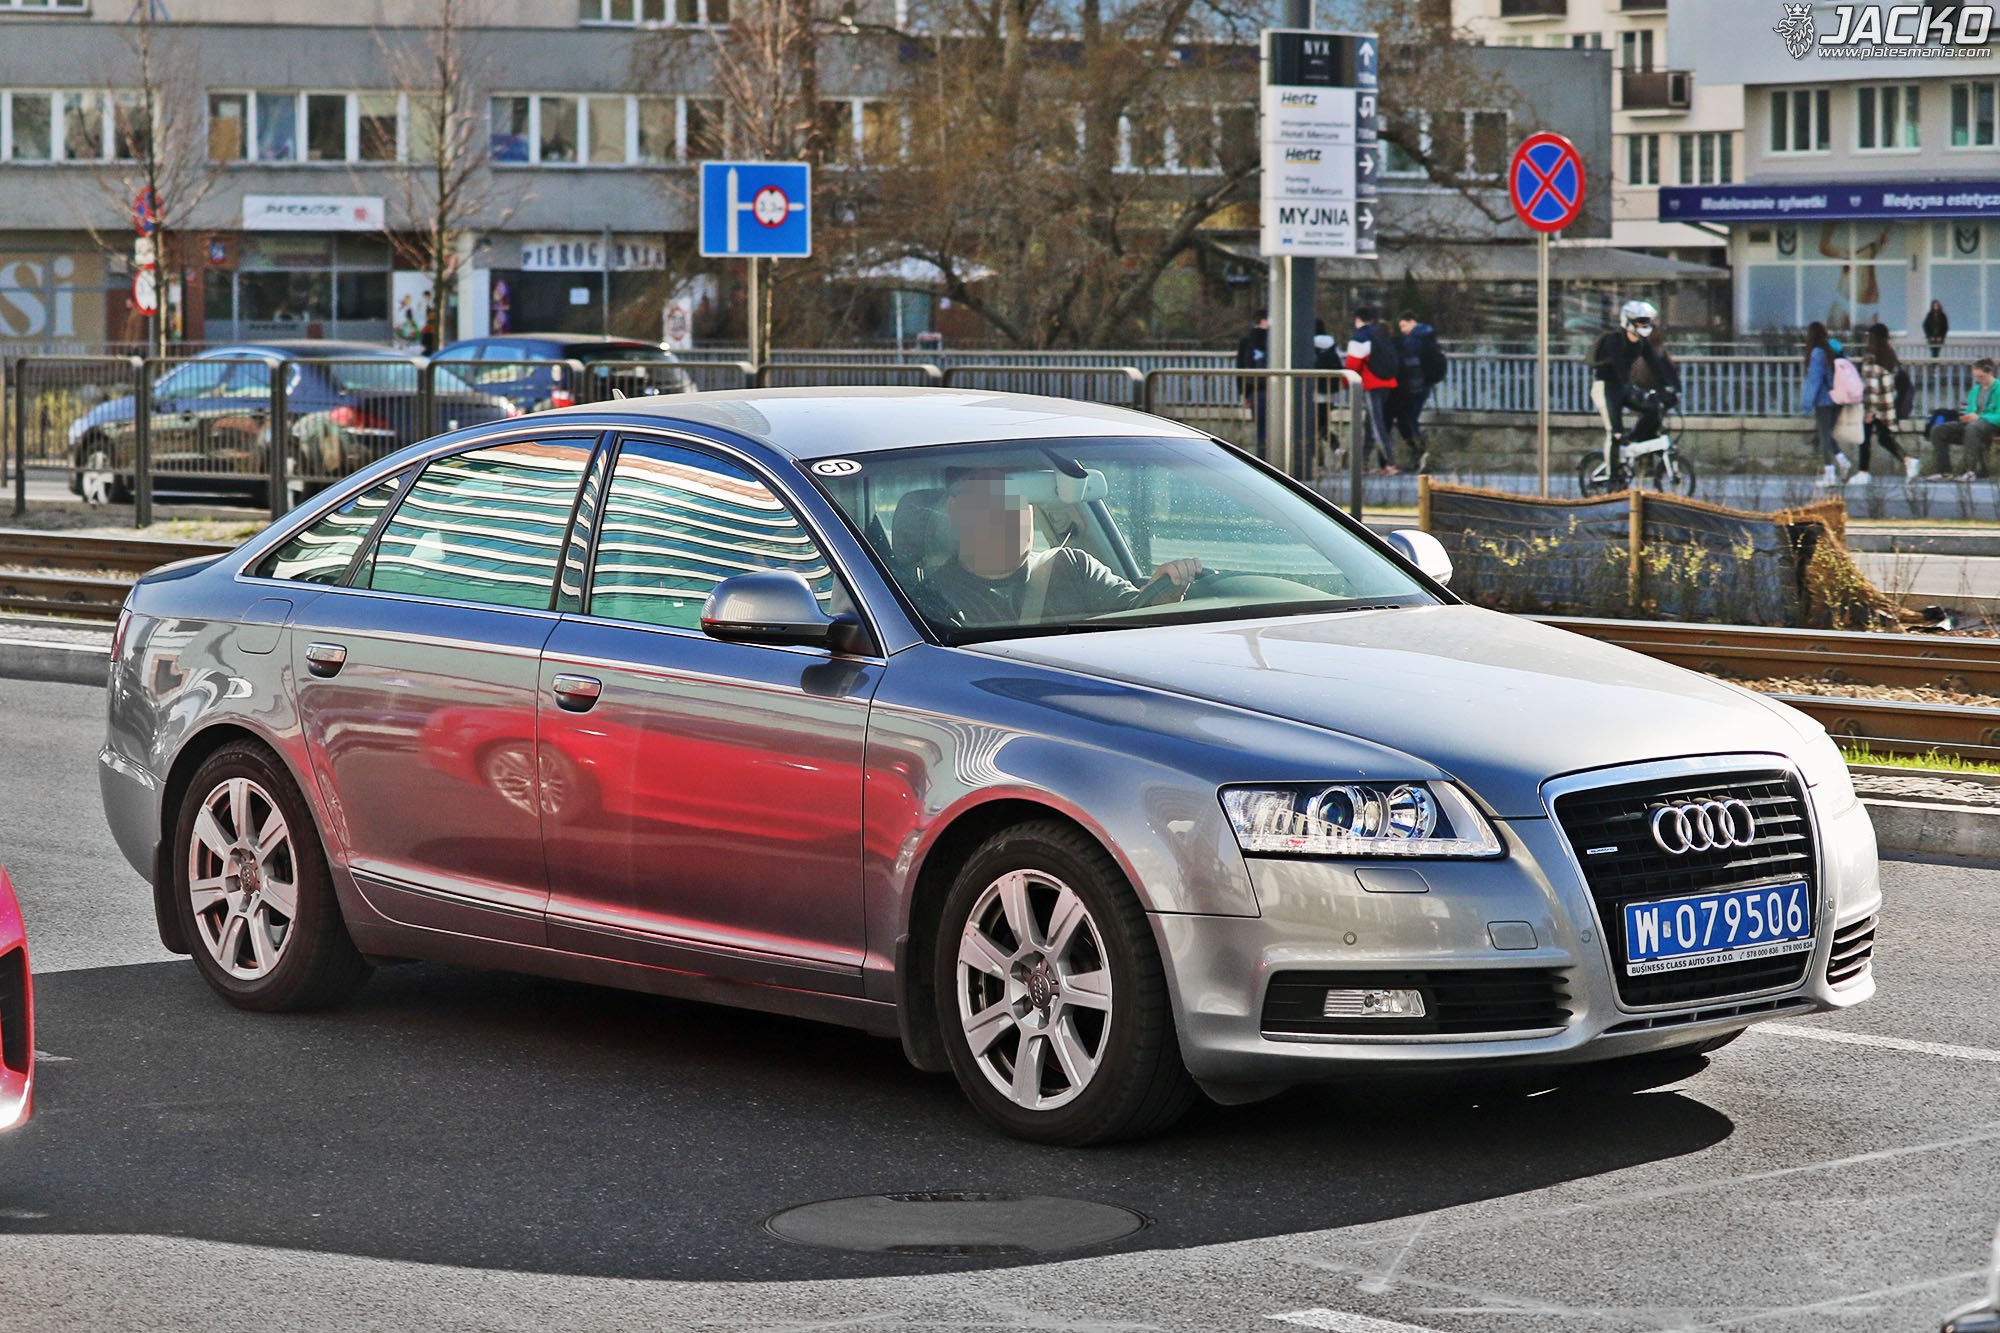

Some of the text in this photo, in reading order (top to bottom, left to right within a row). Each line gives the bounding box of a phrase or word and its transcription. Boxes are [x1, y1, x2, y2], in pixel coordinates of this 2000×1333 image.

[1281, 92, 1318, 105] Hertz
[1285, 148, 1322, 160] Hertz
[1883, 193, 1944, 211] Medycyna
[1279, 207, 1350, 226] MYJNIA
[818, 461, 854, 473] CD
[1635, 887, 1802, 954] W 079506
[1747, 950, 1757, 958] 578
[1757, 949, 1768, 957] 000
[1782, 945, 1792, 953] 578
[1793, 943, 1803, 951] 000
[1631, 963, 1665, 974] BUSINESS
[1666, 960, 1687, 970] CLASS
[1688, 957, 1706, 967] AUTO
[1707, 956, 1716, 964] SP.
